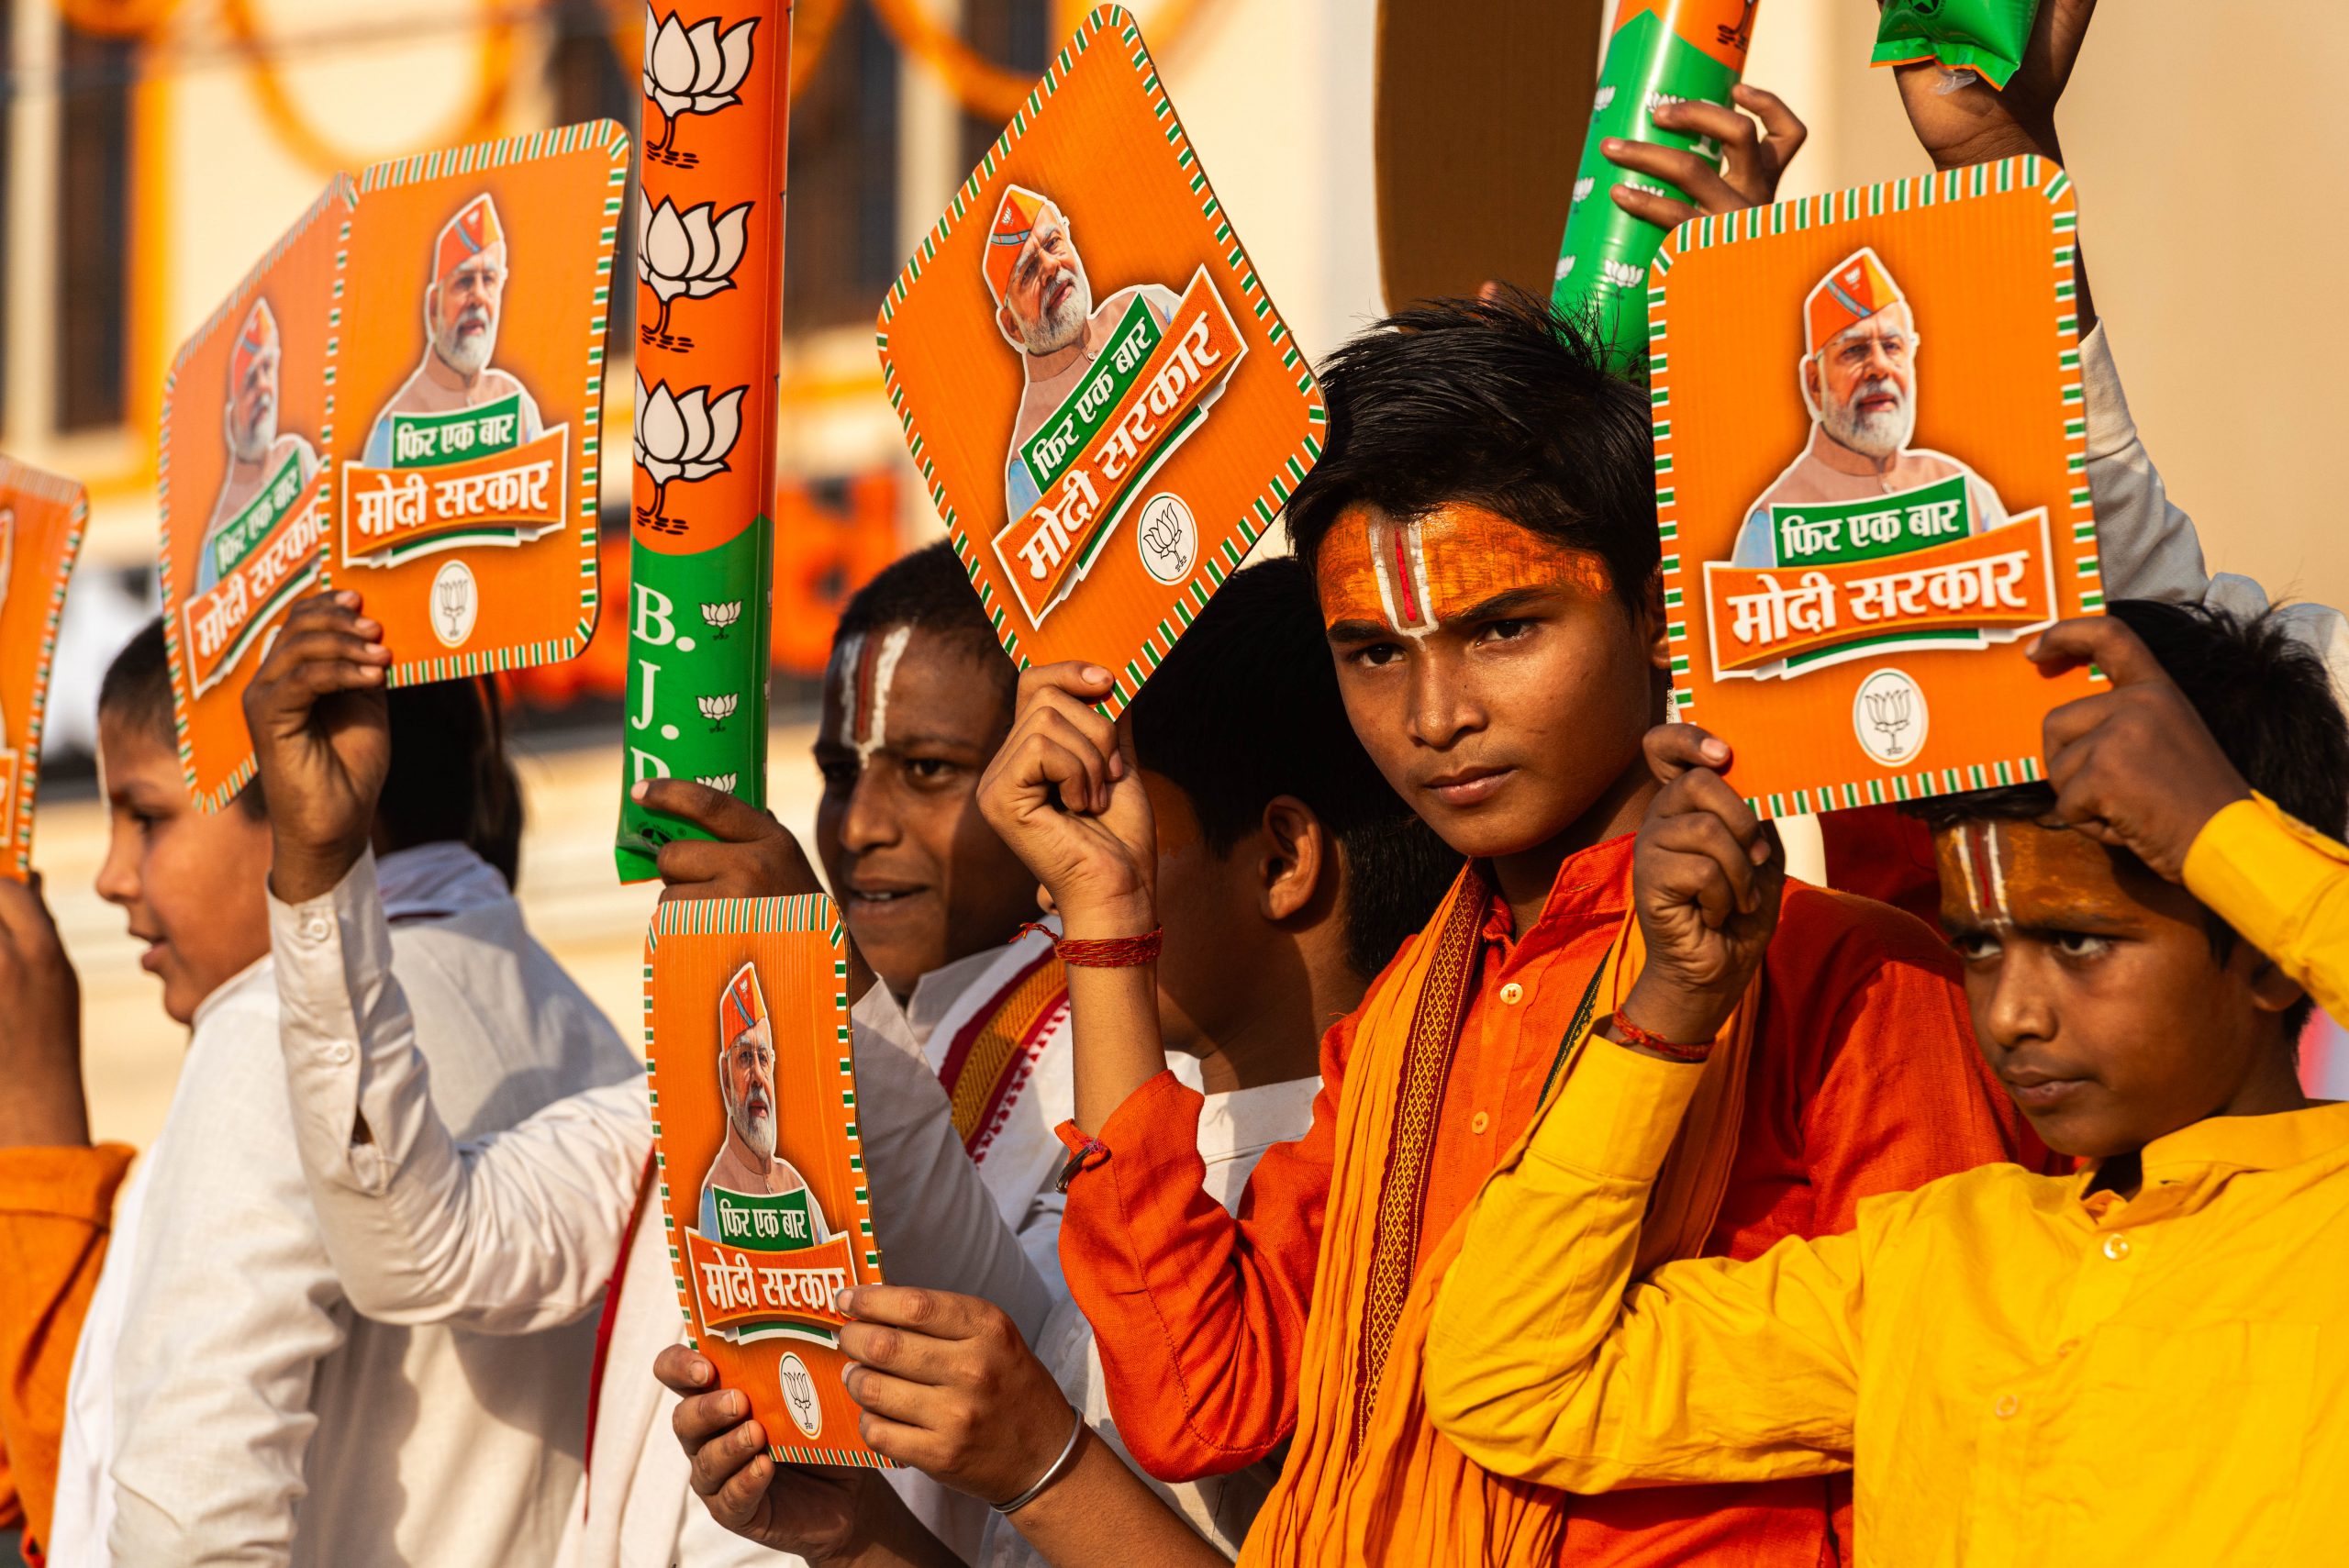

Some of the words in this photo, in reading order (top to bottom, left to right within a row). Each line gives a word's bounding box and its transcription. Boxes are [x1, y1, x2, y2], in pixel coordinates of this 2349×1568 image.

[396, 421, 439, 462] फिर
[440, 420, 477, 450] एक
[479, 414, 516, 447] बार
[1032, 412, 1081, 482] फिर
[1074, 364, 1115, 425] एक
[1111, 317, 1154, 376] बार
[1017, 469, 1101, 582] मोदी
[1094, 310, 1222, 482] सरकार
[355, 473, 429, 537] मोदी
[434, 460, 554, 518] सरकार
[1780, 514, 1843, 559] फिर
[1847, 509, 1902, 548] एक
[1906, 499, 1962, 538] बार
[195, 572, 249, 658] मोदी
[248, 495, 322, 599] सरका
[1726, 571, 1837, 645] मोदी
[1844, 550, 2031, 623] सरकार
[719, 1197, 752, 1239] फिर
[751, 1208, 781, 1239] एक
[780, 1209, 808, 1240] बार
[700, 1247, 758, 1311] मोदी
